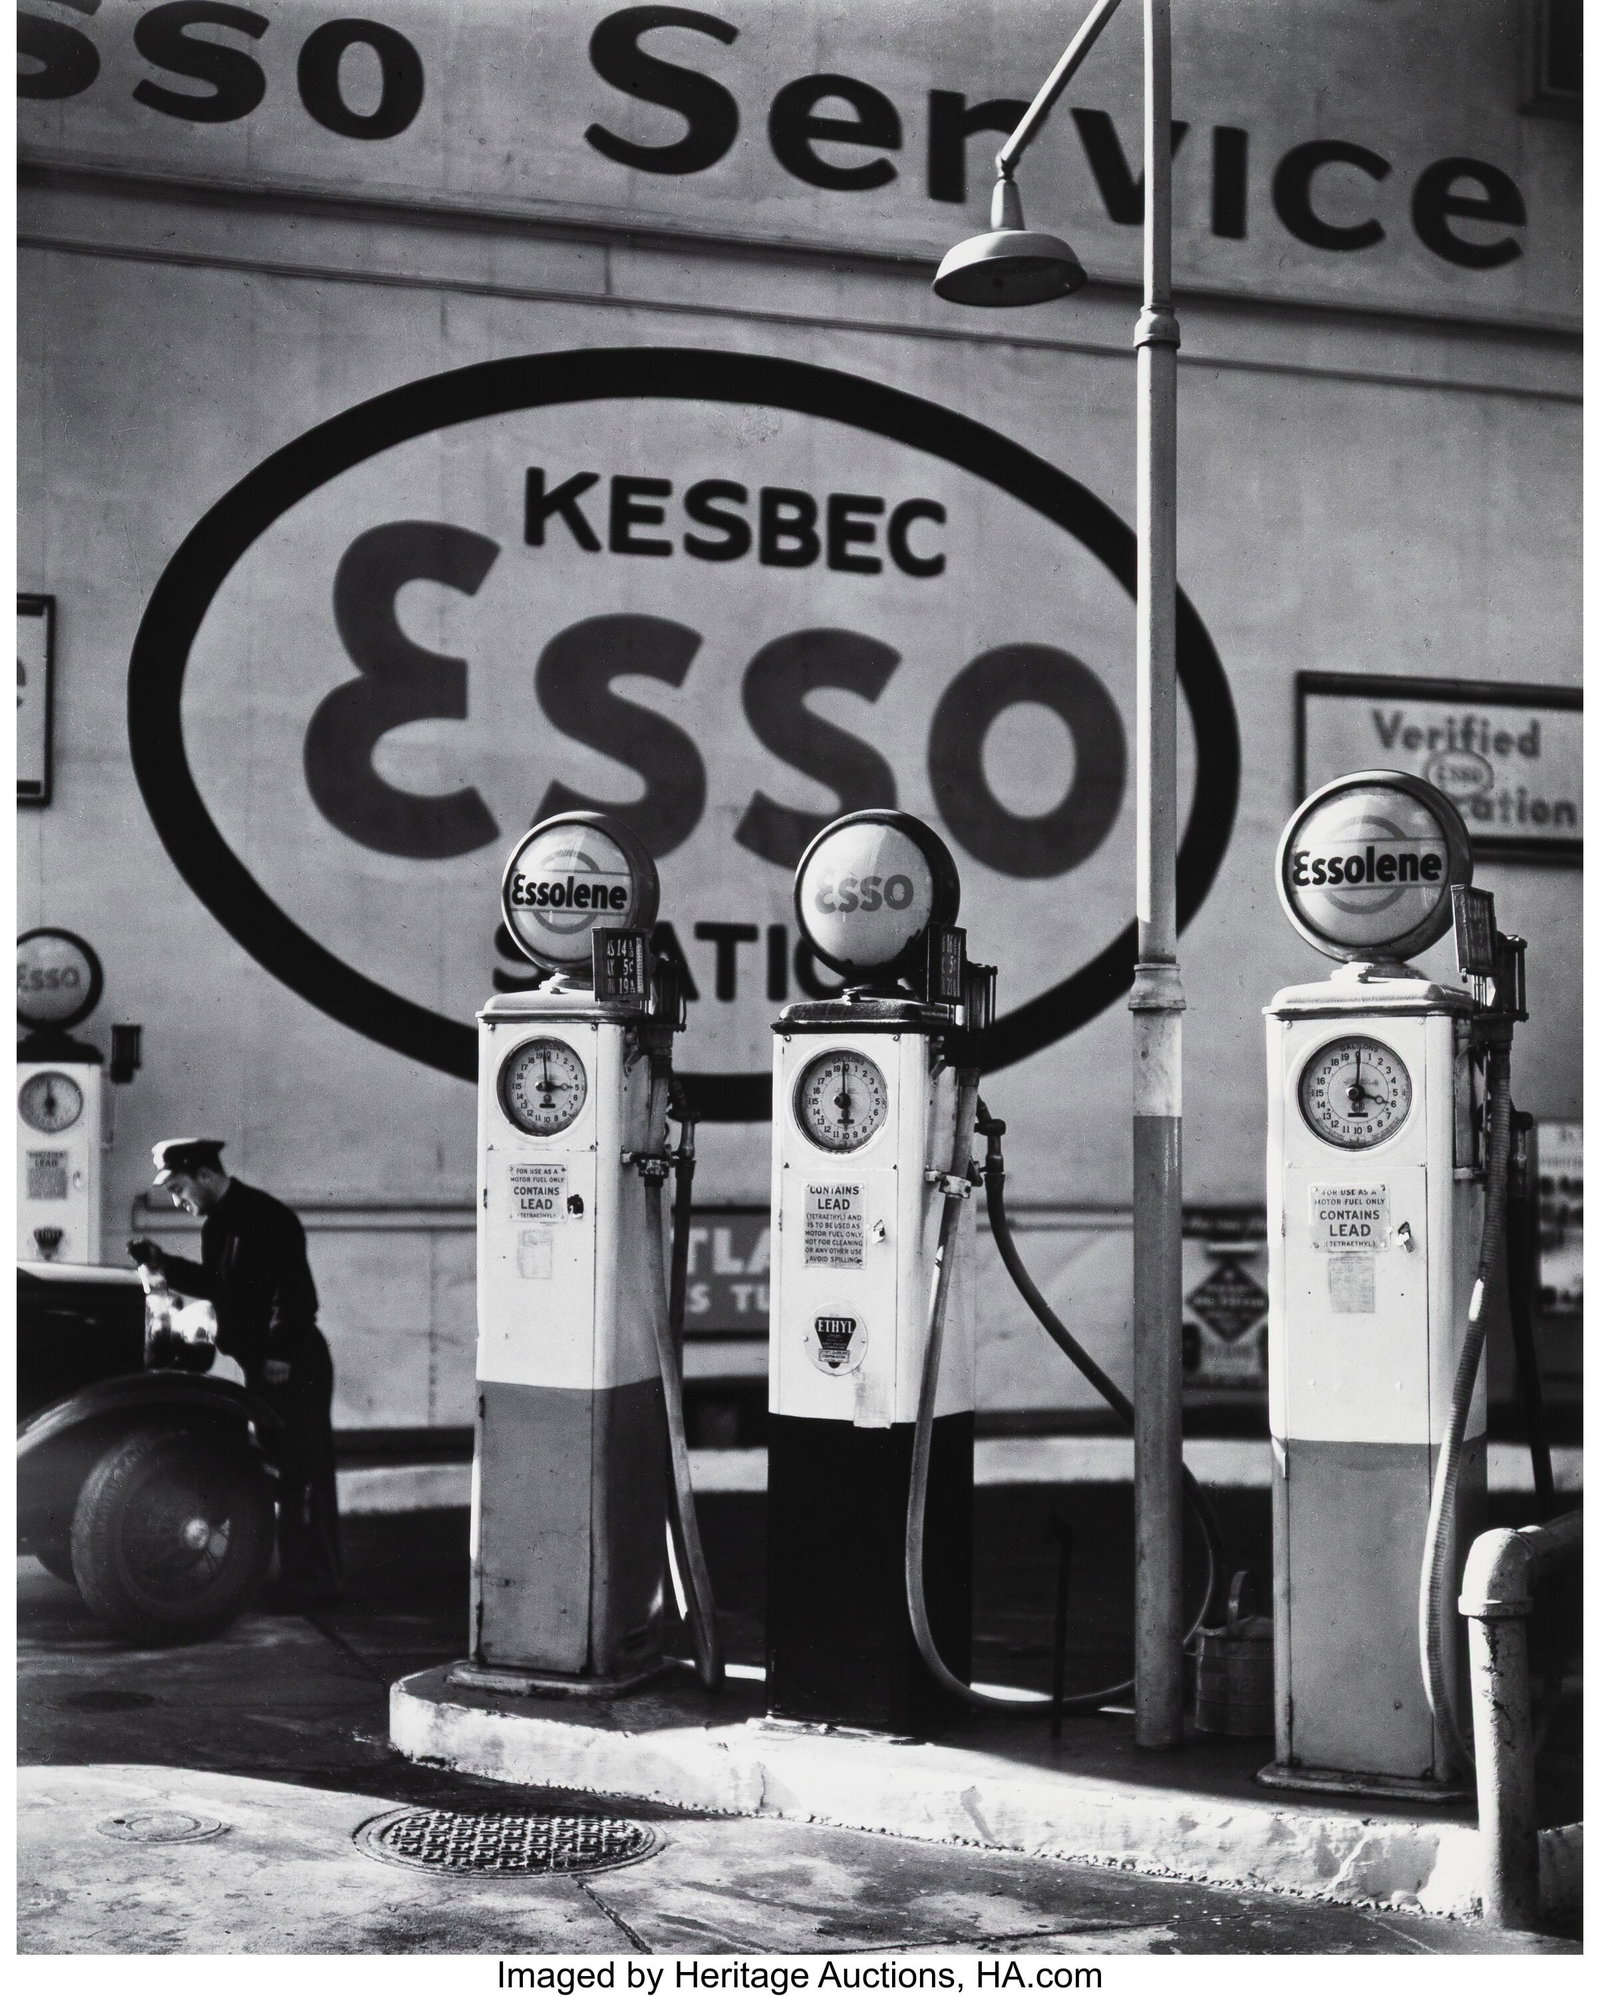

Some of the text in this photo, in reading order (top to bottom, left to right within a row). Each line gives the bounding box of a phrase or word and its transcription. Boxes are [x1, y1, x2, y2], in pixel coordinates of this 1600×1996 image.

[583, 4, 1527, 270] Service
[525, 466, 947, 578] KESBEC
[1372, 708, 1542, 759] Verified
[1293, 846, 1442, 886] Essolene
[512, 874, 627, 909] Essolene
[1340, 1053, 1350, 1061] 19
[1331, 1058, 1340, 1066] 18
[1316, 1077, 1326, 1085] 16
[1315, 1089, 1324, 1097] 15
[527, 1109, 534, 1117] 12
[813, 1108, 820, 1116] 14
[1322, 1112, 1332, 1120] 13
[1330, 1120, 1339, 1128] 12
[842, 1132, 850, 1140] 10
[514, 1187, 560, 1195] CONTAINS
[810, 1186, 859, 1195] CONTAINS
[521, 1199, 552, 1209] LEAD
[818, 1199, 850, 1210] LEAD
[1320, 1210, 1380, 1220] CONTAINS
[1330, 1224, 1371, 1237] LEAD
[818, 1320, 853, 1333] ETHYL
